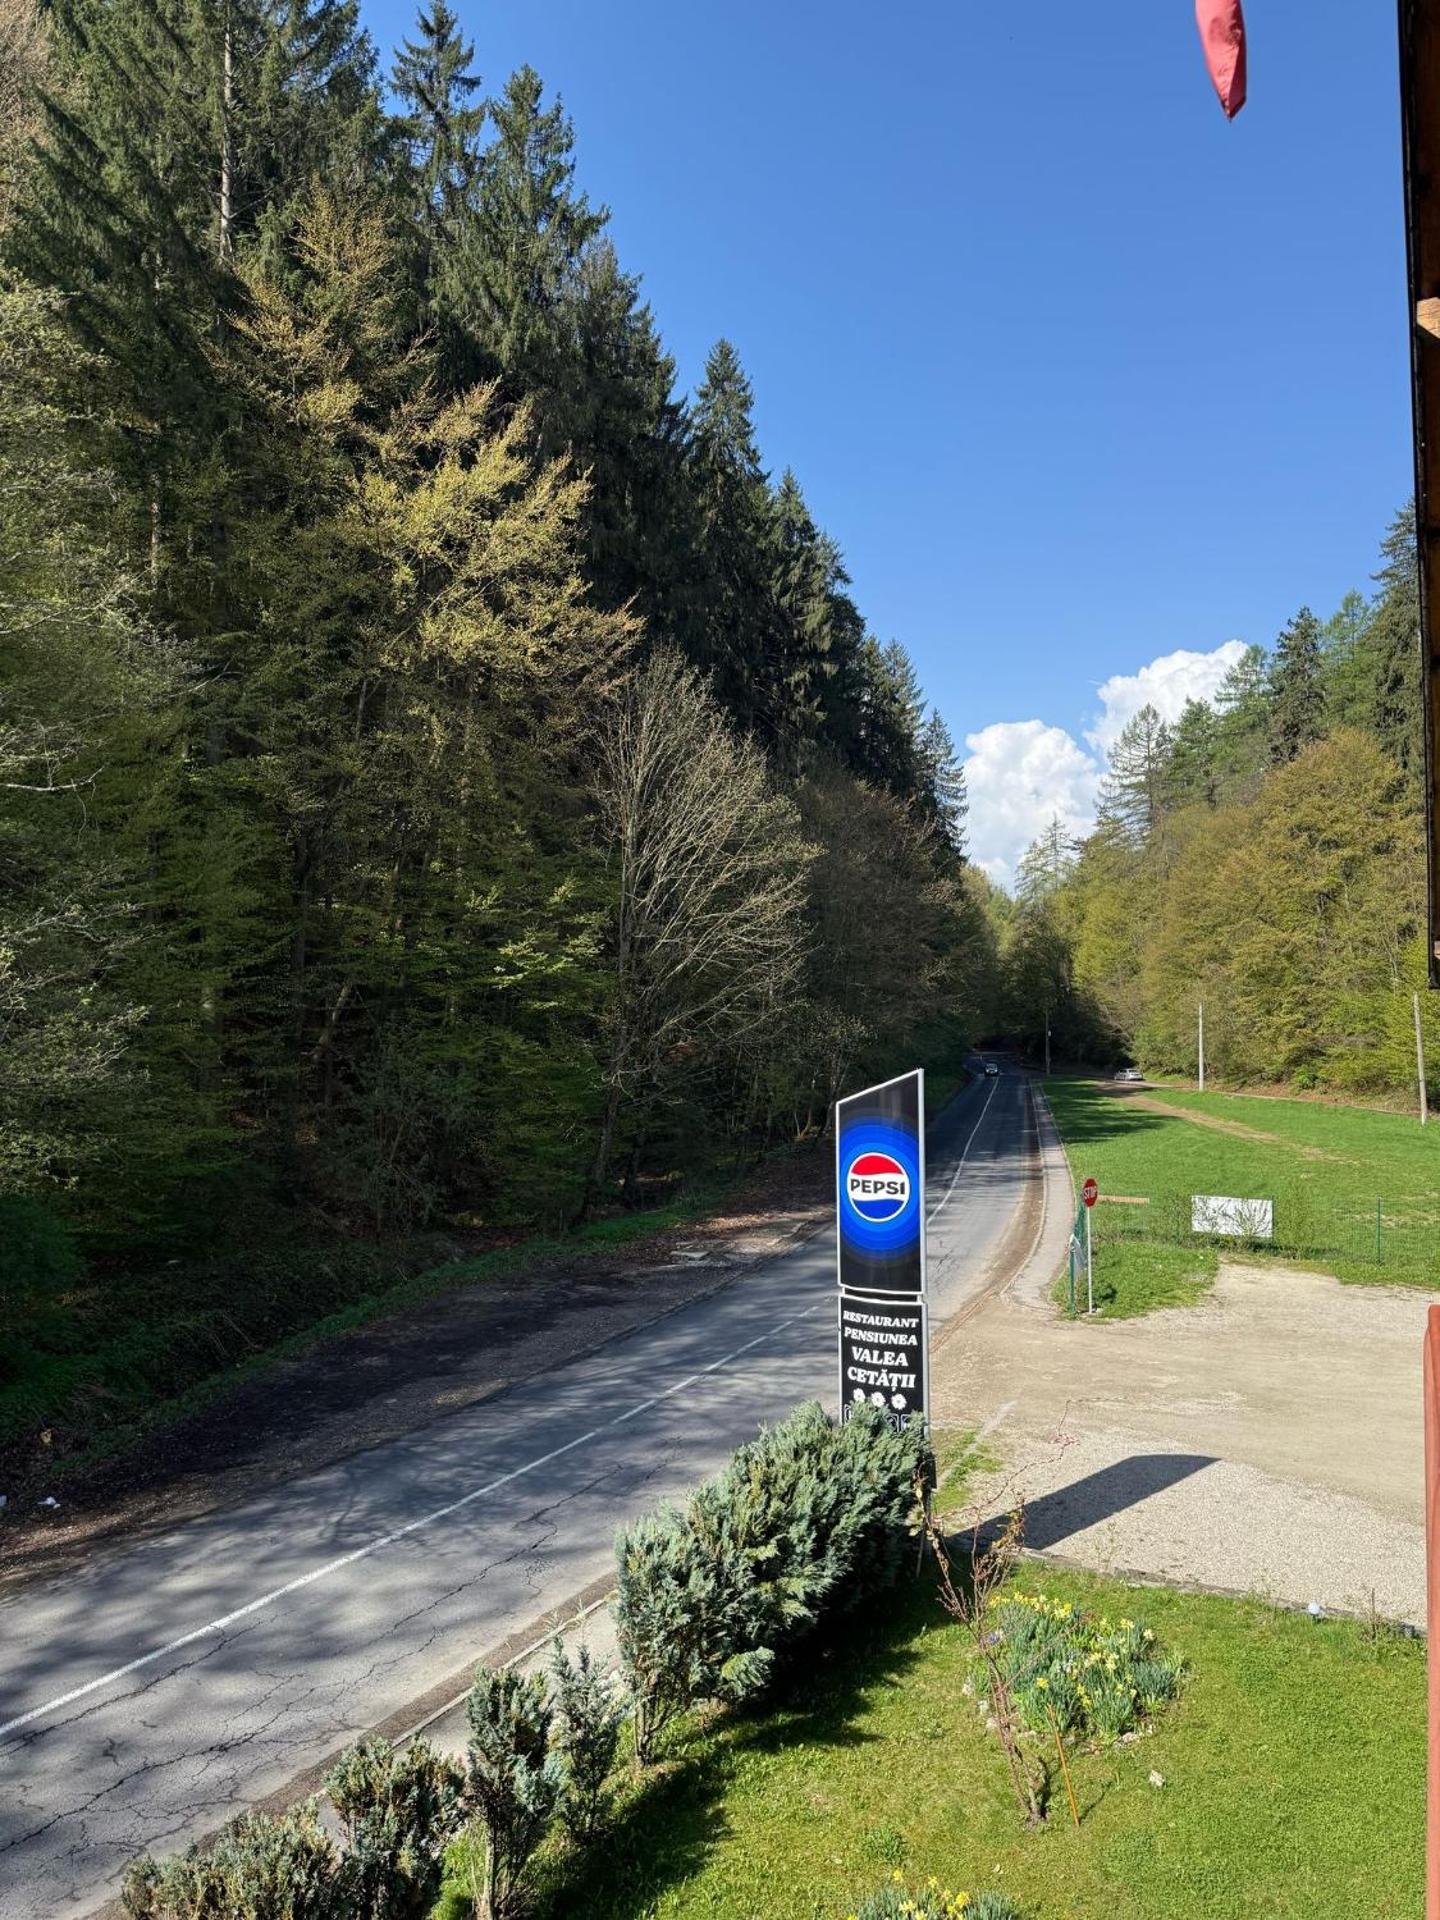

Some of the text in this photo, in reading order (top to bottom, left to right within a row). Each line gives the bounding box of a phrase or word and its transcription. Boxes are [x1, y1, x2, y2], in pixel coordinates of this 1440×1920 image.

[850, 1178, 906, 1195] PEPSI
[1083, 1185, 1097, 1199] STOP
[843, 1310, 919, 1328] RESTAURANT
[844, 1326, 918, 1346] PENSIUNEA
[851, 1346, 909, 1367] VALEA
[847, 1366, 916, 1392] CETĂȚII
